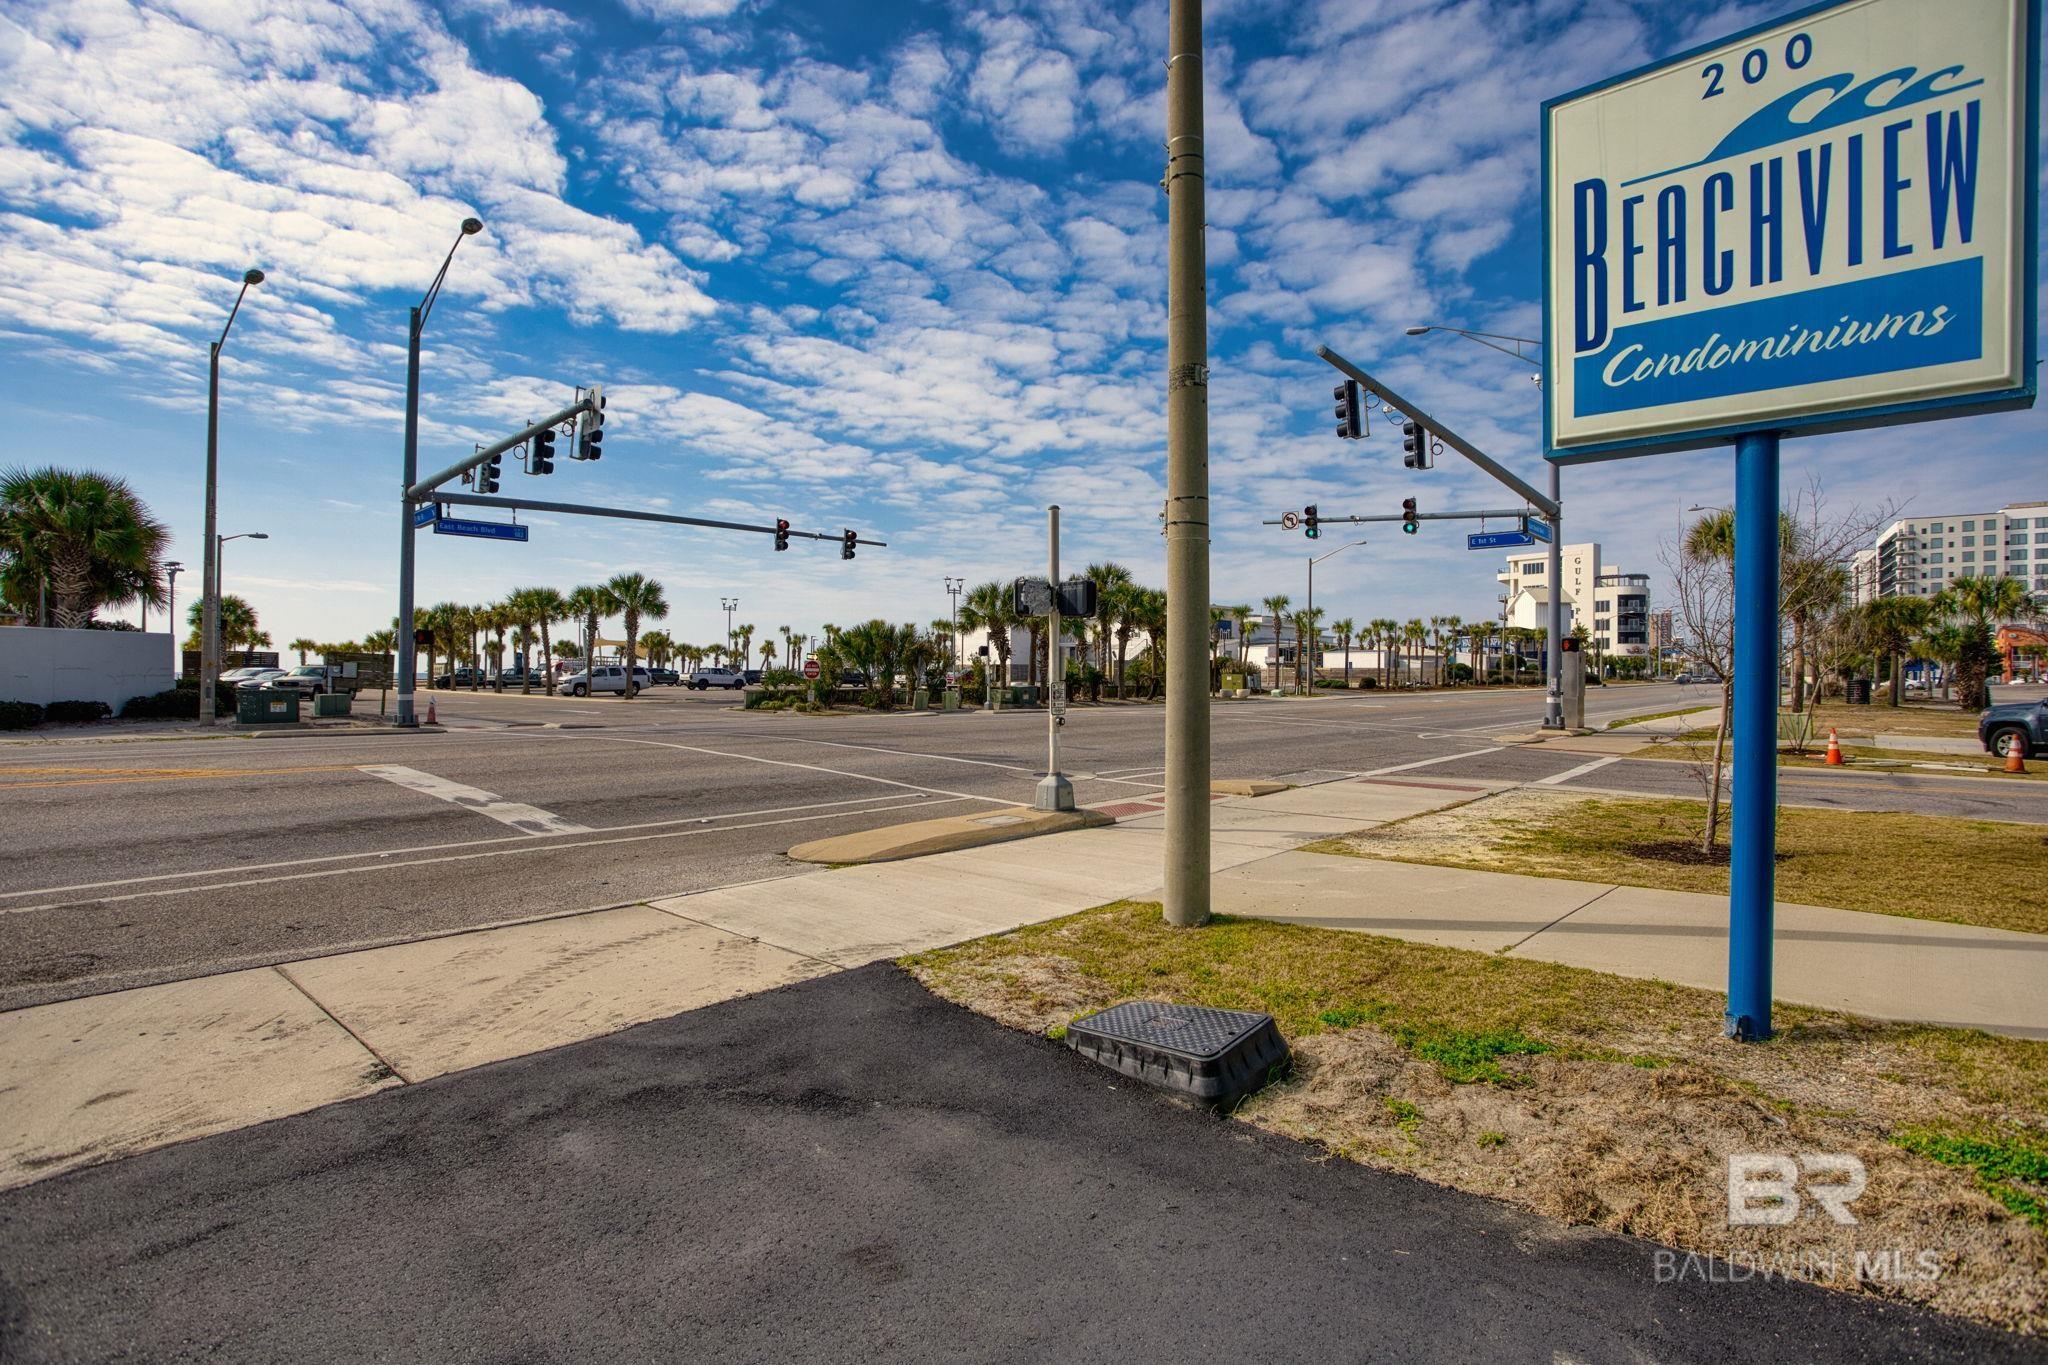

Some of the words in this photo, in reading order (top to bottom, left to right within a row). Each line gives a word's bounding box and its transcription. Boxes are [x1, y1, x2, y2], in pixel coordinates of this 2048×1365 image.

[1701, 33, 1813, 100] 200
[1574, 99, 1980, 354] BEACHVIEW
[1602, 303, 1957, 387] Condominiums
[1574, 557, 1582, 596] GULF
